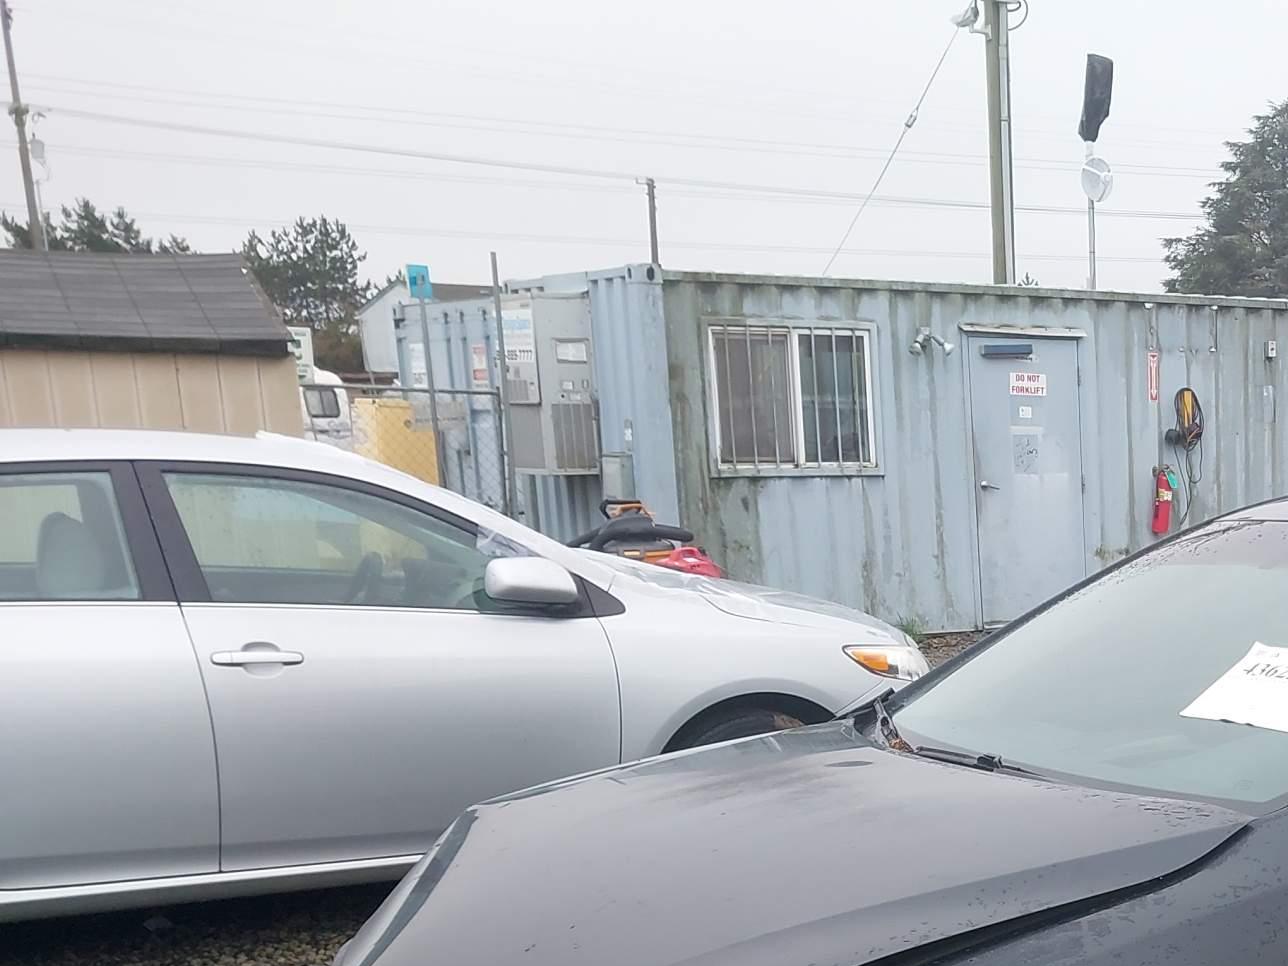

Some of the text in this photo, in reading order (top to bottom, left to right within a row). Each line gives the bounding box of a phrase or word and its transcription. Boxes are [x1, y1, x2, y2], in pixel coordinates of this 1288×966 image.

[1015, 374, 1040, 383] DO NOT
[1012, 385, 1044, 395] FORKLIFT
